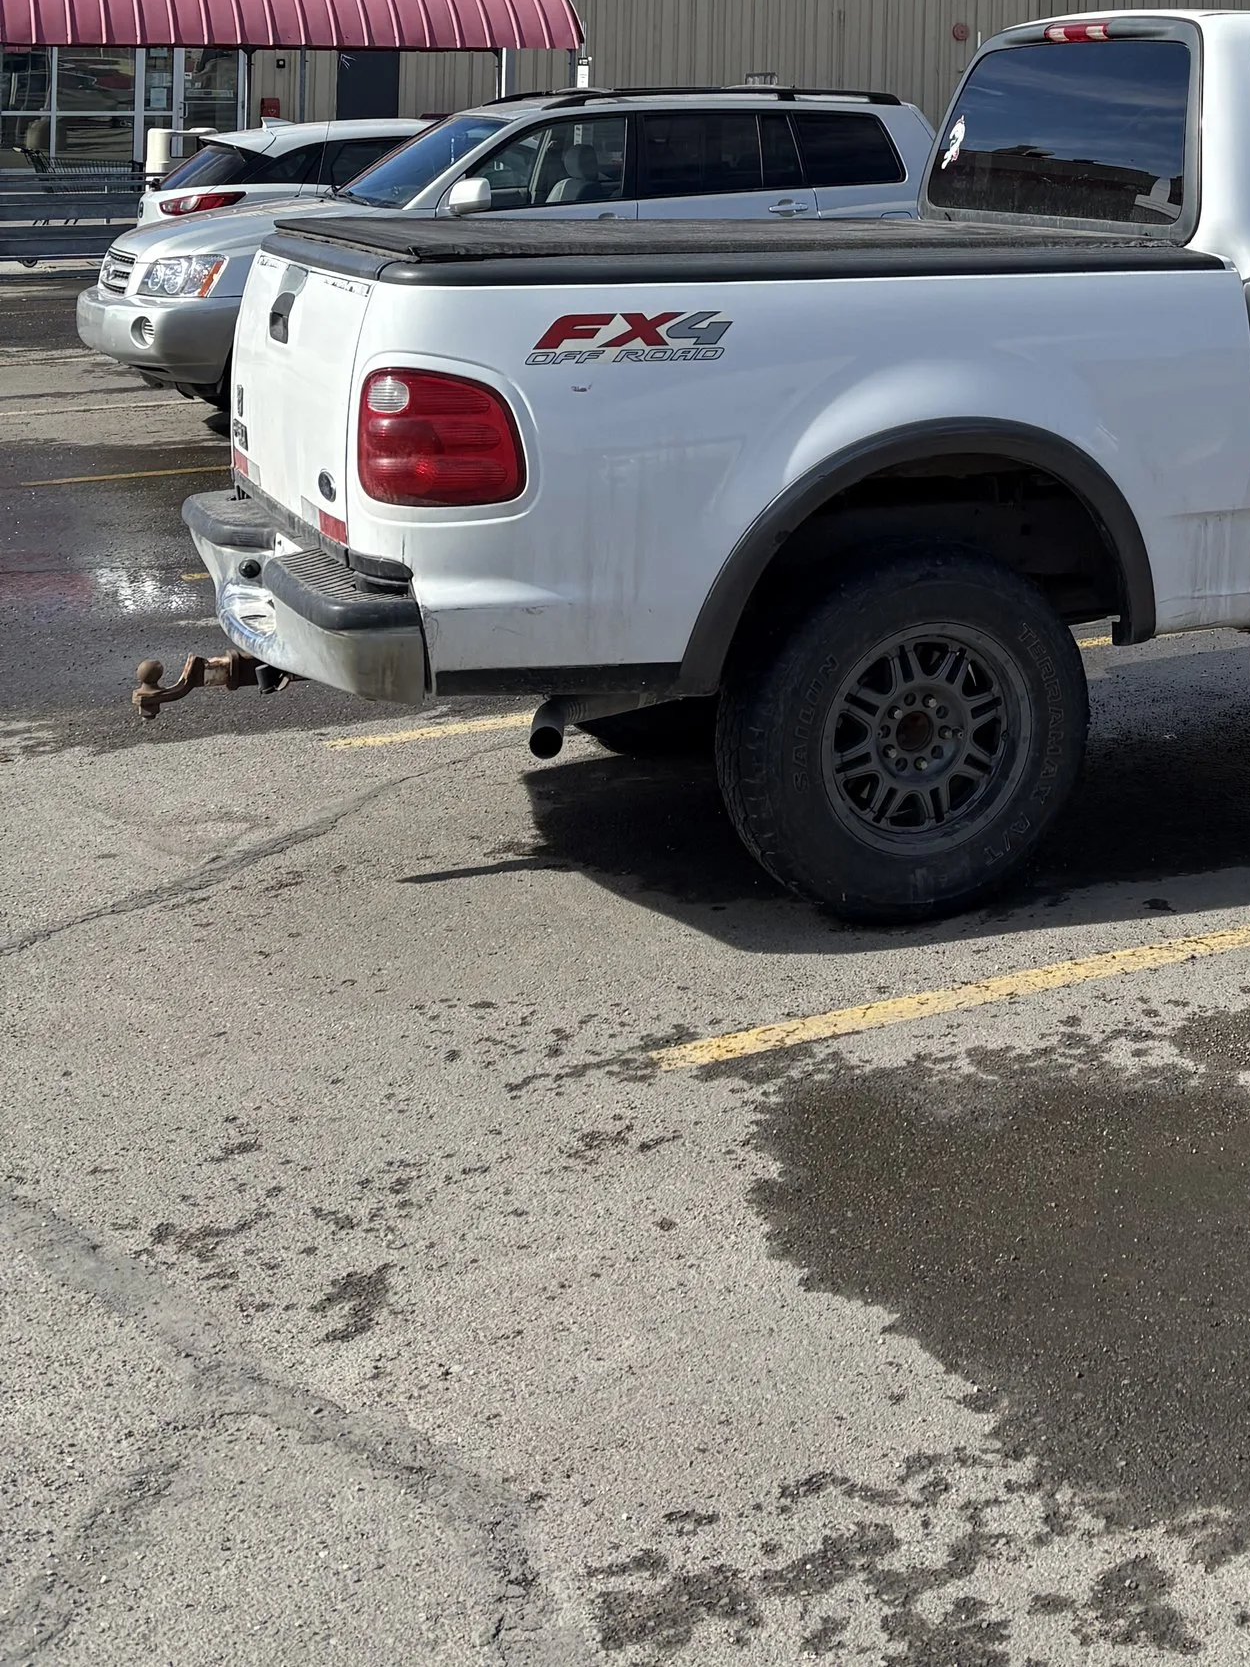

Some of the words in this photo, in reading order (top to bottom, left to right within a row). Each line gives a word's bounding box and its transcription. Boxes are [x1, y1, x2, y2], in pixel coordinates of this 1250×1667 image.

[532, 310, 734, 350] FX4
[524, 349, 605, 366] OFF
[611, 346, 726, 363] ROAD
[1017, 621, 1066, 806] TERRAMAX
